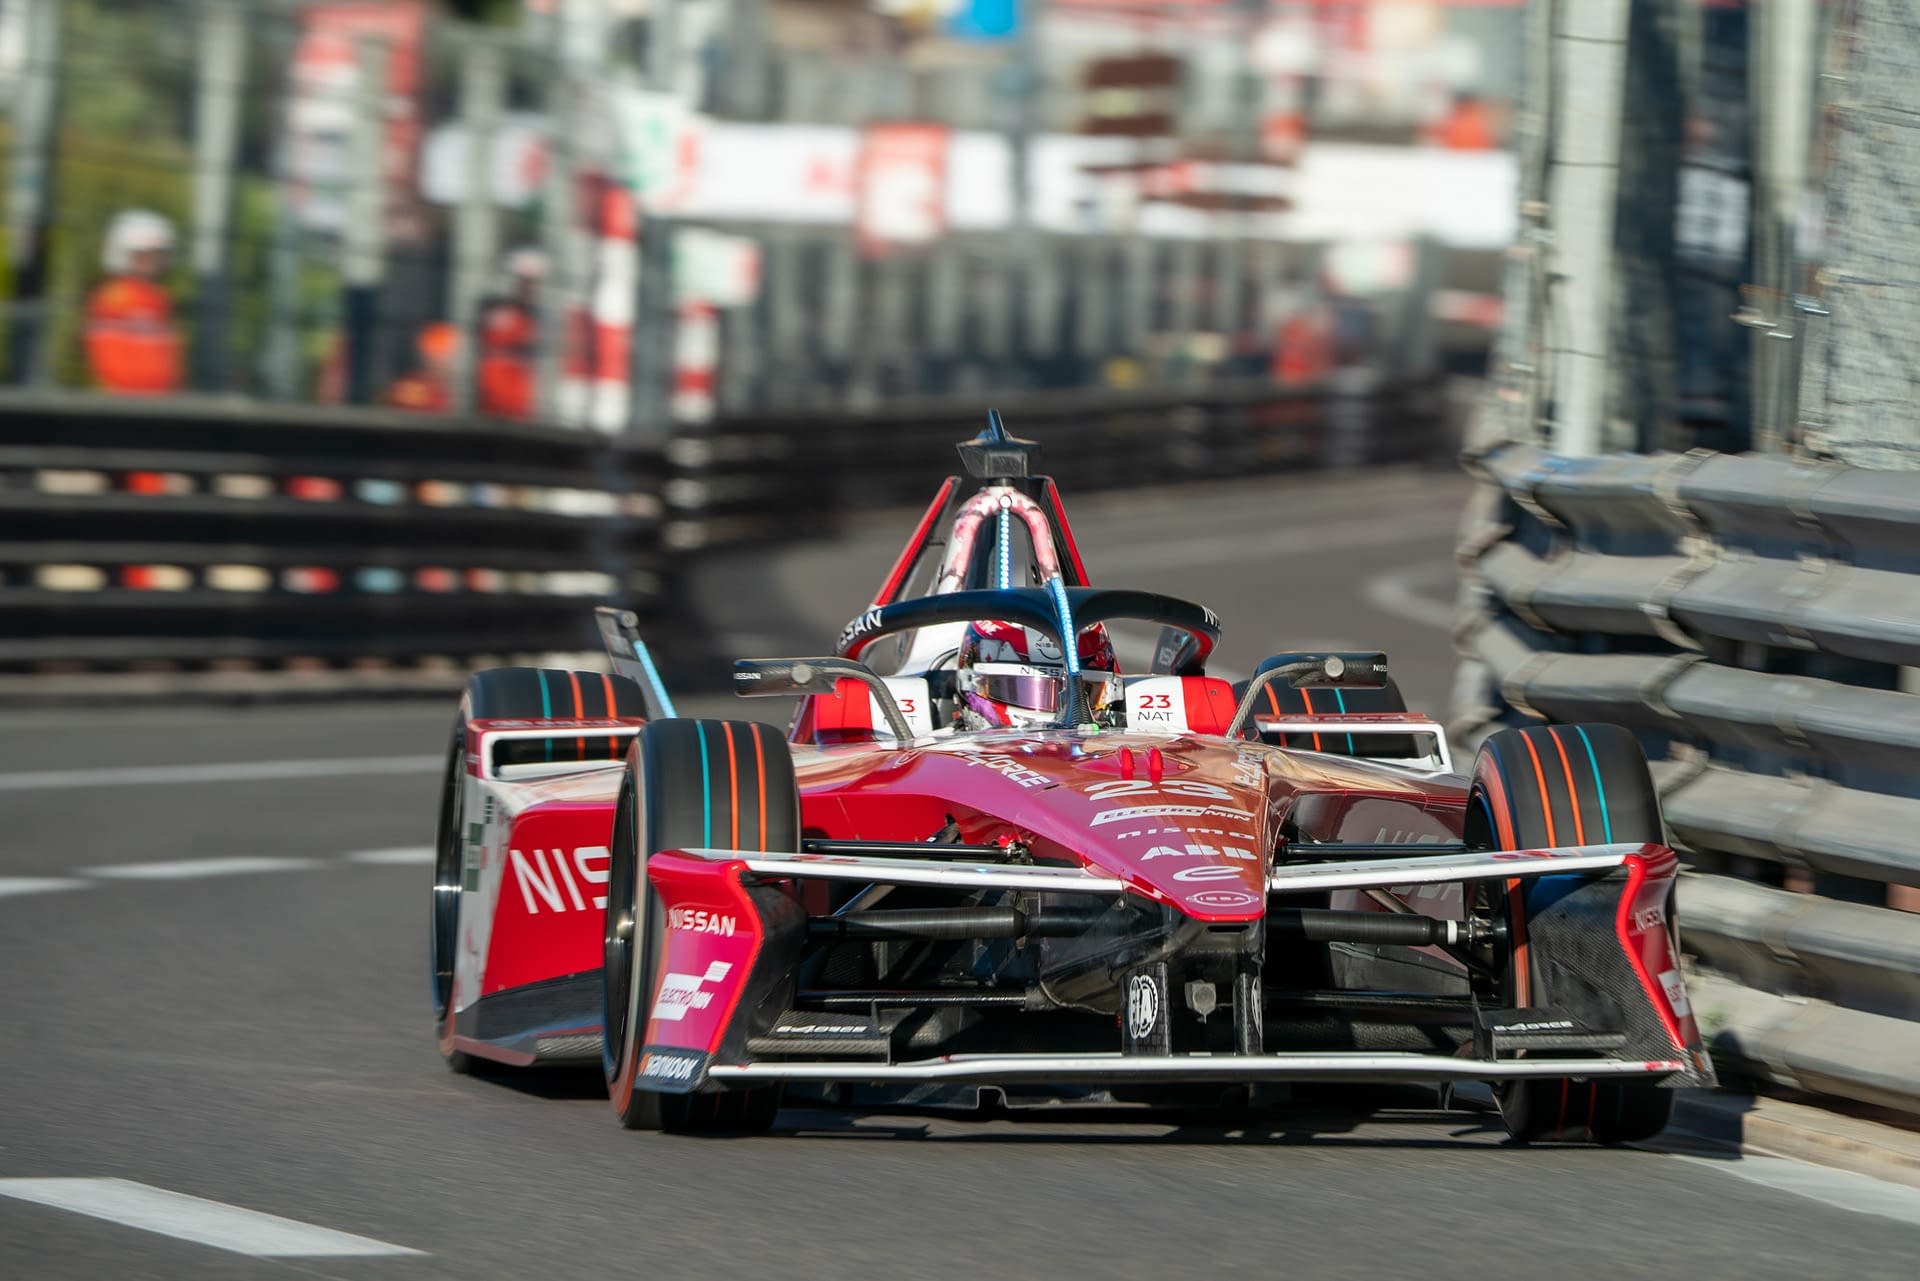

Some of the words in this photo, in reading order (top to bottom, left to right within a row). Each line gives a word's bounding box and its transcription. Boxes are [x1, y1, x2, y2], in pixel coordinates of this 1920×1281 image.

[1139, 695, 1172, 709] 23
[1137, 711, 1174, 722] NAT
[1084, 780, 1234, 801] 23
[668, 908, 736, 937] NISSAN
